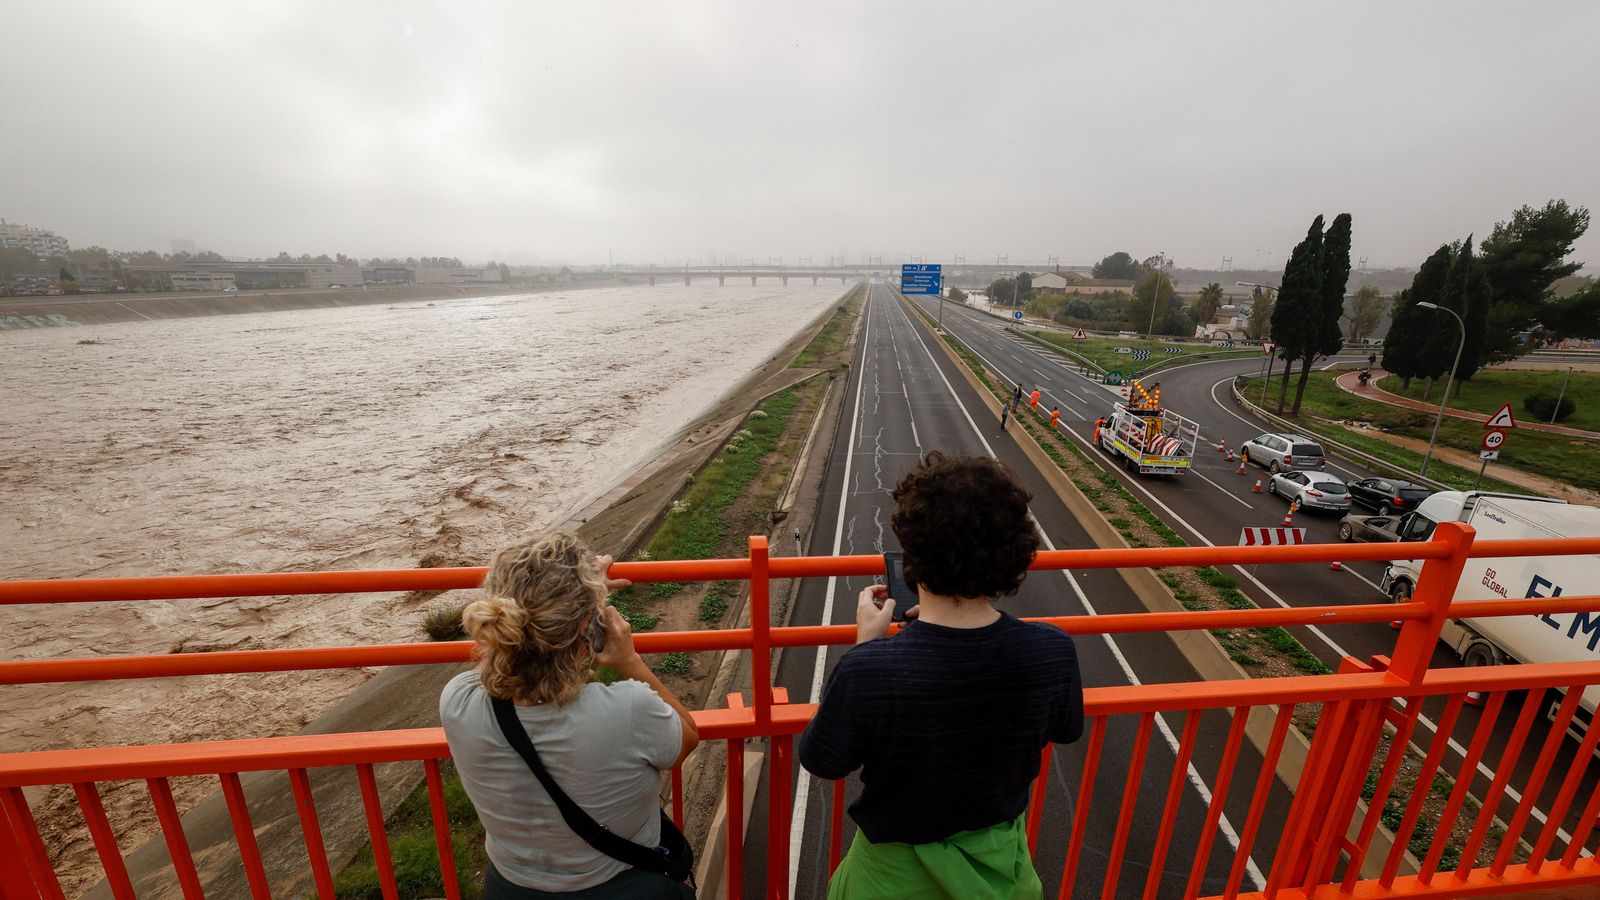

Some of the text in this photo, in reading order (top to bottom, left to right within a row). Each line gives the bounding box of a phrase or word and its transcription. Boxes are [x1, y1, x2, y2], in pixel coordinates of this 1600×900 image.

[1488, 436, 1501, 444] 40
[1485, 567, 1497, 579] GO
[1481, 576, 1508, 599] GLOBAL
